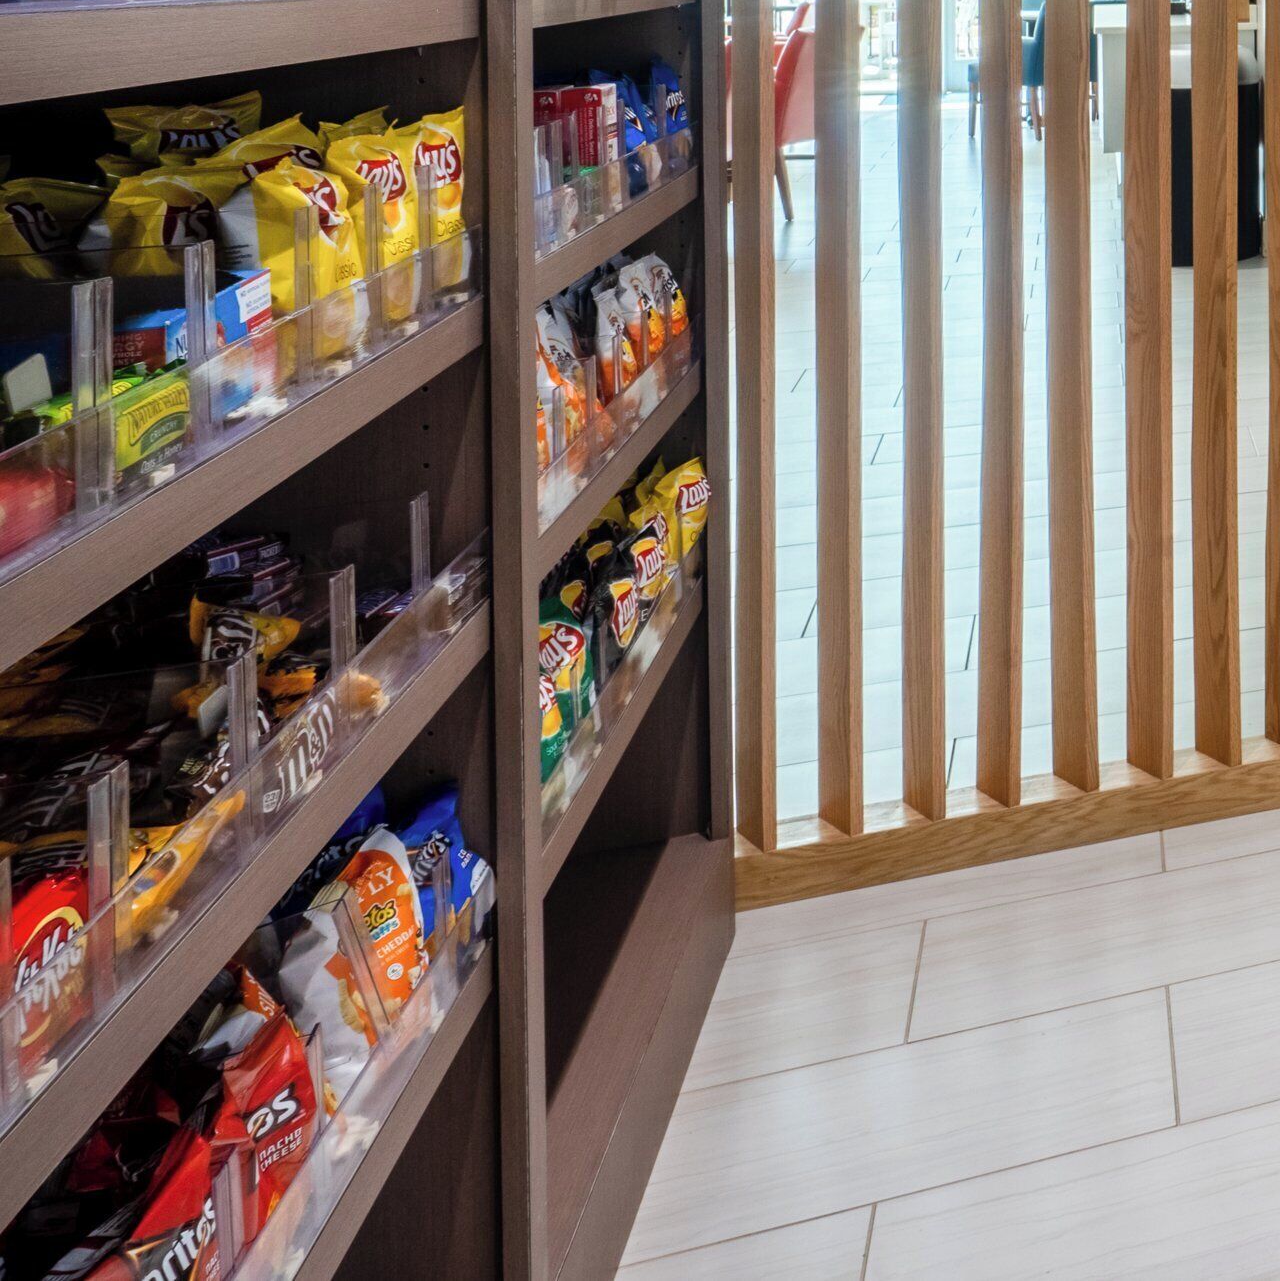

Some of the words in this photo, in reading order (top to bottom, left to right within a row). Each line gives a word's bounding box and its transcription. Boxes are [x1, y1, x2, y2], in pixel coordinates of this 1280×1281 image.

[130, 398, 163, 438] NATURE
[680, 477, 711, 515] Lay's
[638, 544, 665, 588] Lay's
[539, 627, 578, 675] ay's
[259, 1126, 303, 1161] NACHO
[259, 1138, 304, 1172] CHEESE
